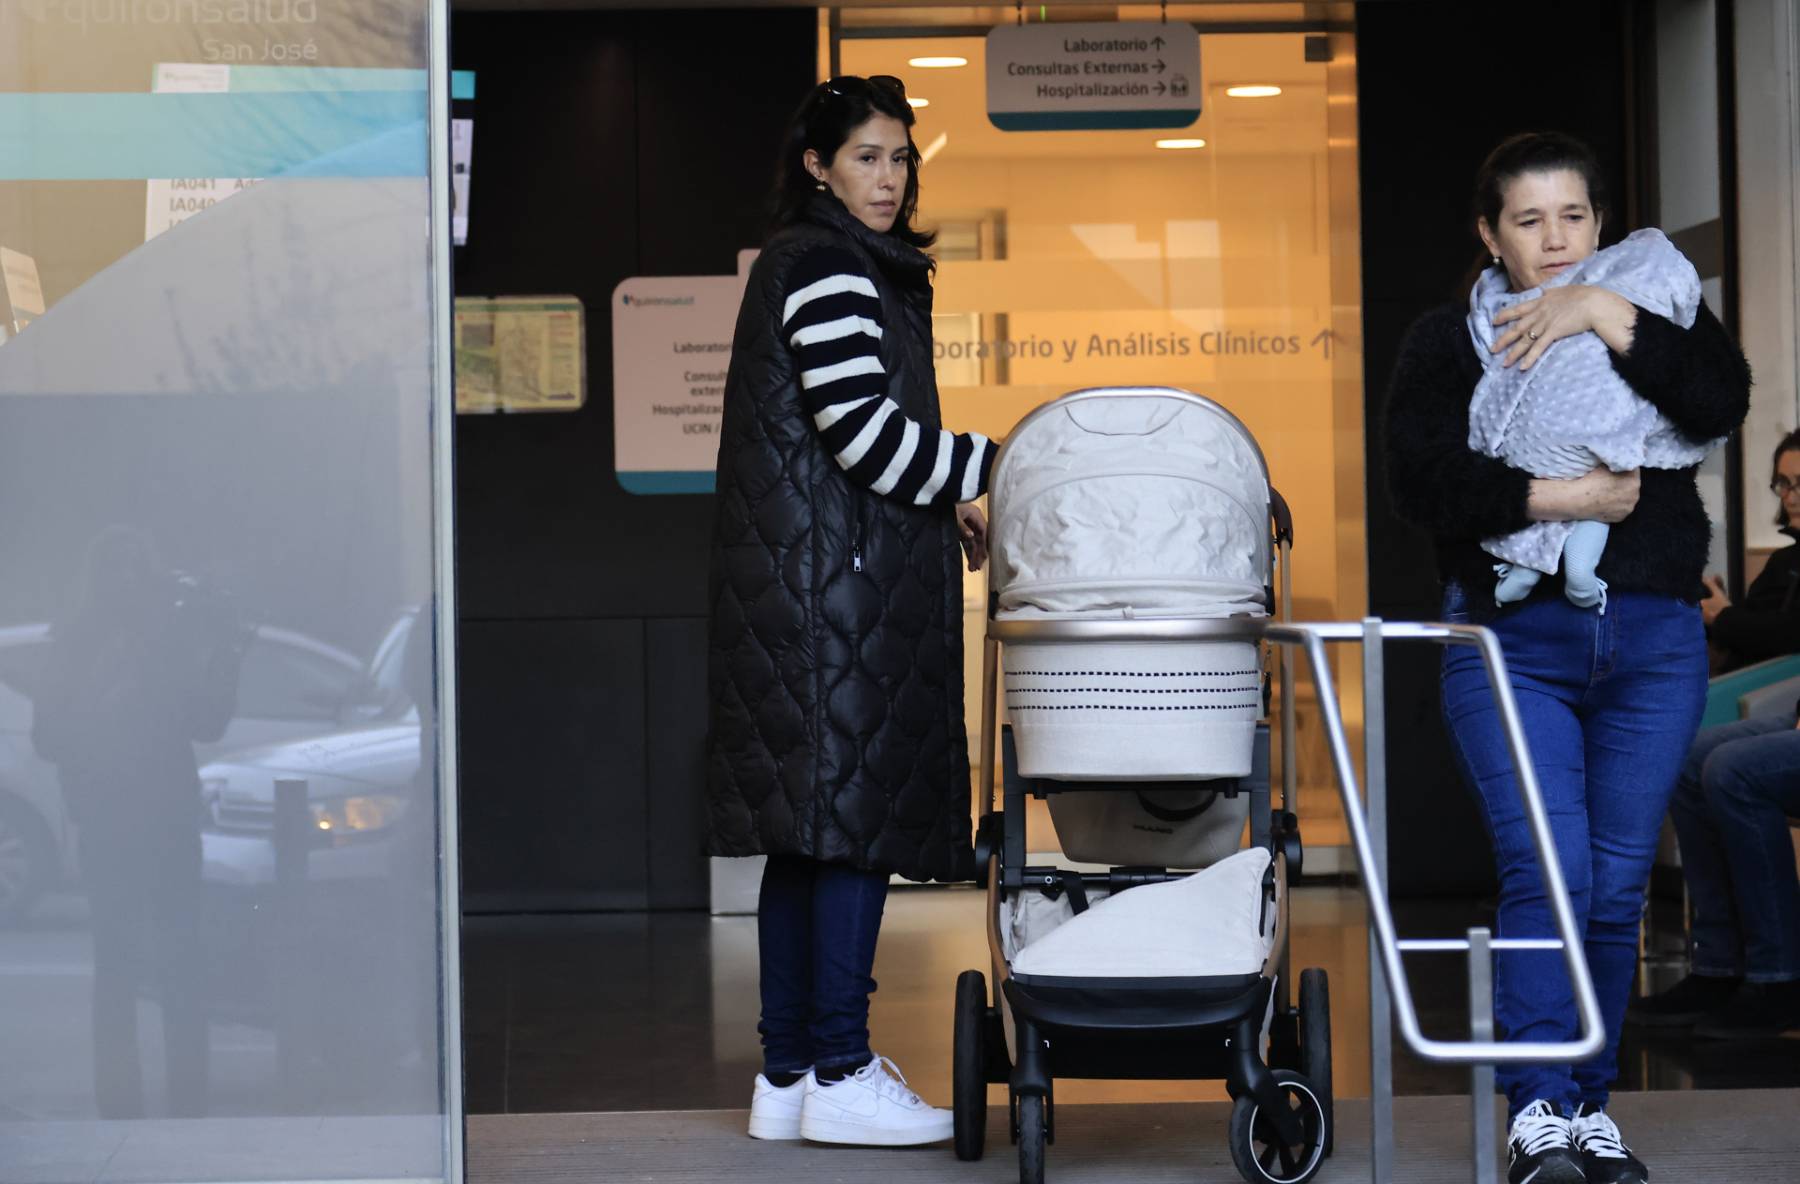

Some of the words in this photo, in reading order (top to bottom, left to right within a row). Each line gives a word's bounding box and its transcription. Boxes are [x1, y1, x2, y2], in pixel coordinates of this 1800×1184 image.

[204, 39, 254, 61] San
[261, 38, 318, 61] José
[1063, 37, 1148, 53] Laboratorio
[1008, 60, 1080, 76] Consultas
[1084, 60, 1149, 75] Externas
[1037, 82, 1149, 99] Hospitalización
[1063, 339, 1078, 362] y
[1087, 331, 1191, 357] Análisis
[1199, 329, 1301, 356] Clínicos
